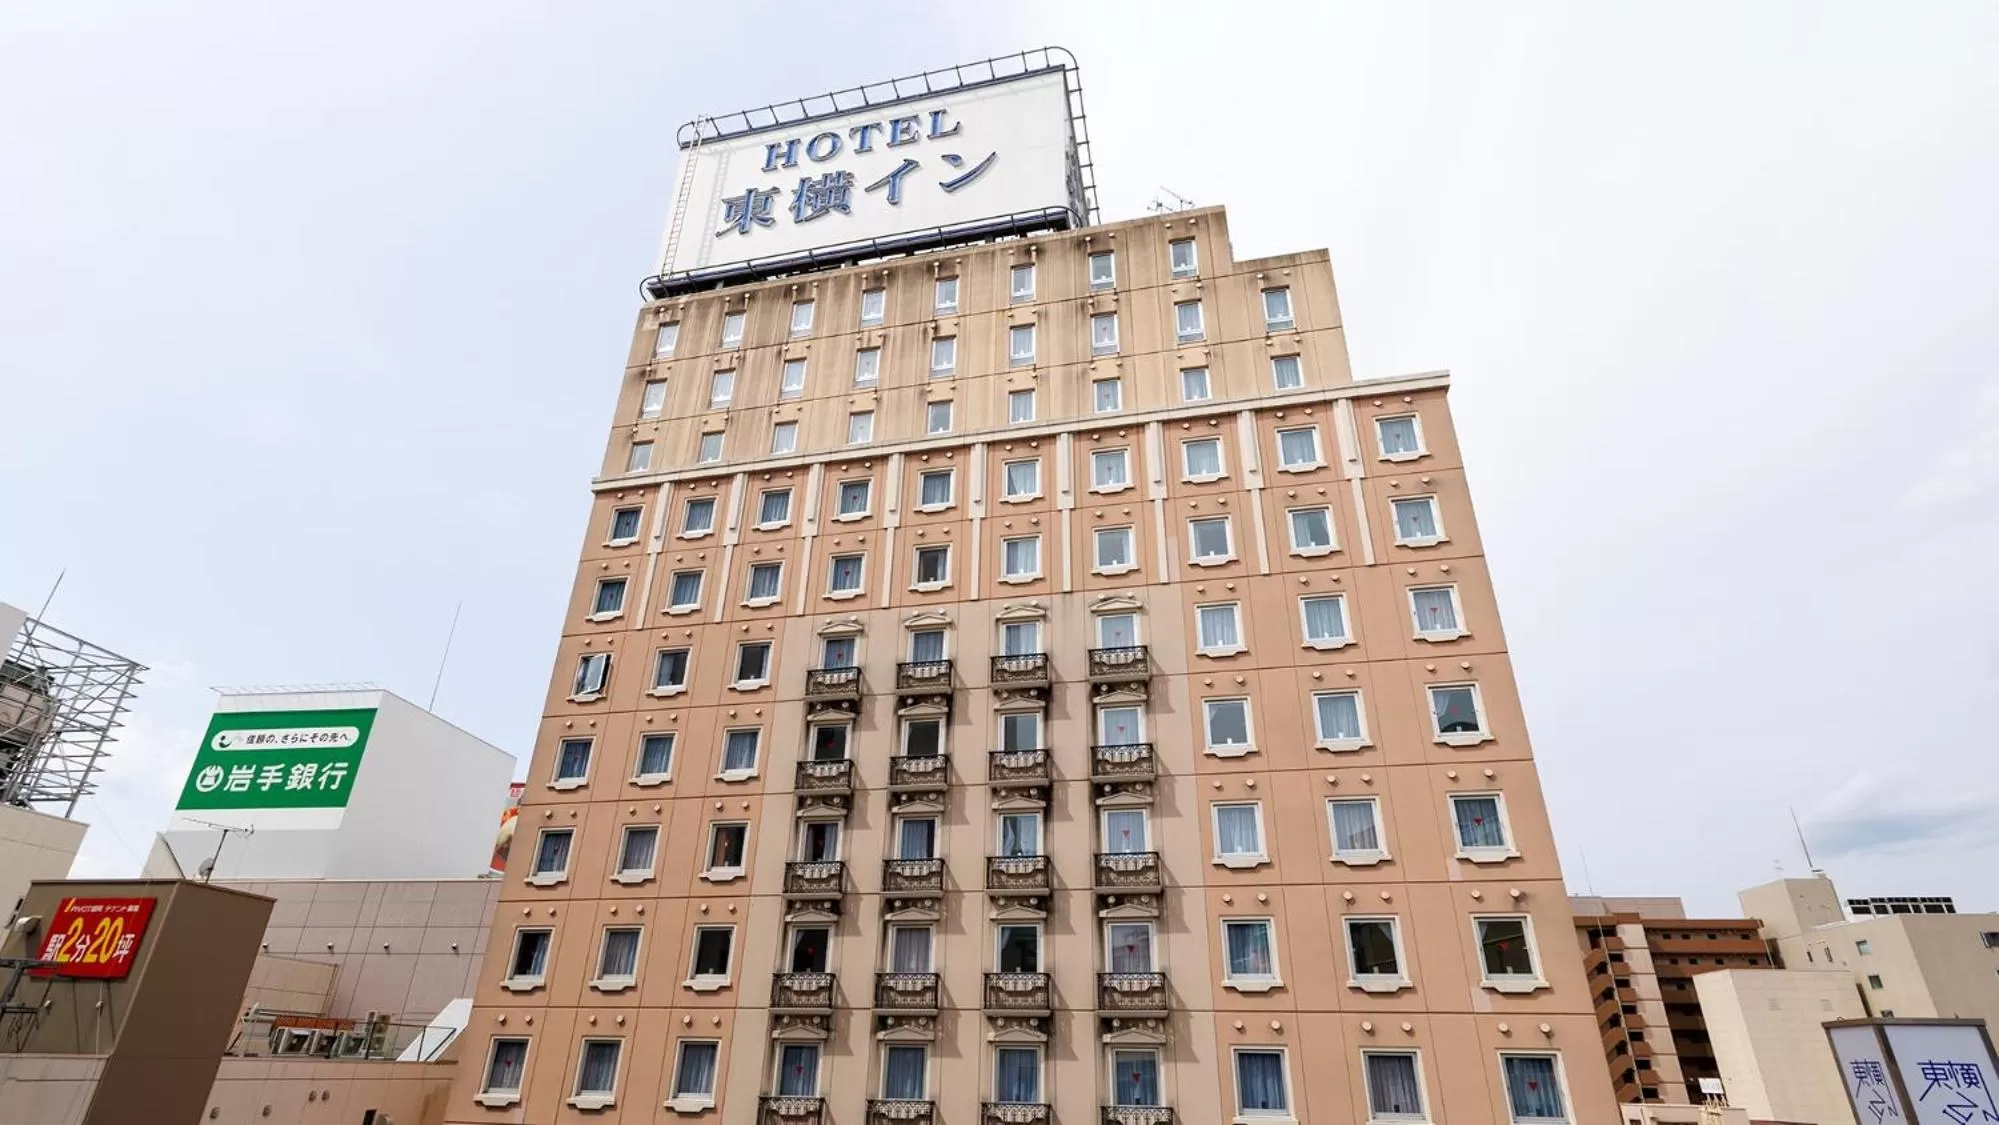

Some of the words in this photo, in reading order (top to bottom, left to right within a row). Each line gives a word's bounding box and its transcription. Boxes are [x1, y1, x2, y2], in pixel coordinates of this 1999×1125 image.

[761, 109, 961, 172] HOTEL
[715, 151, 997, 238] 東横イン
[223, 761, 349, 793] 岩手銀行
